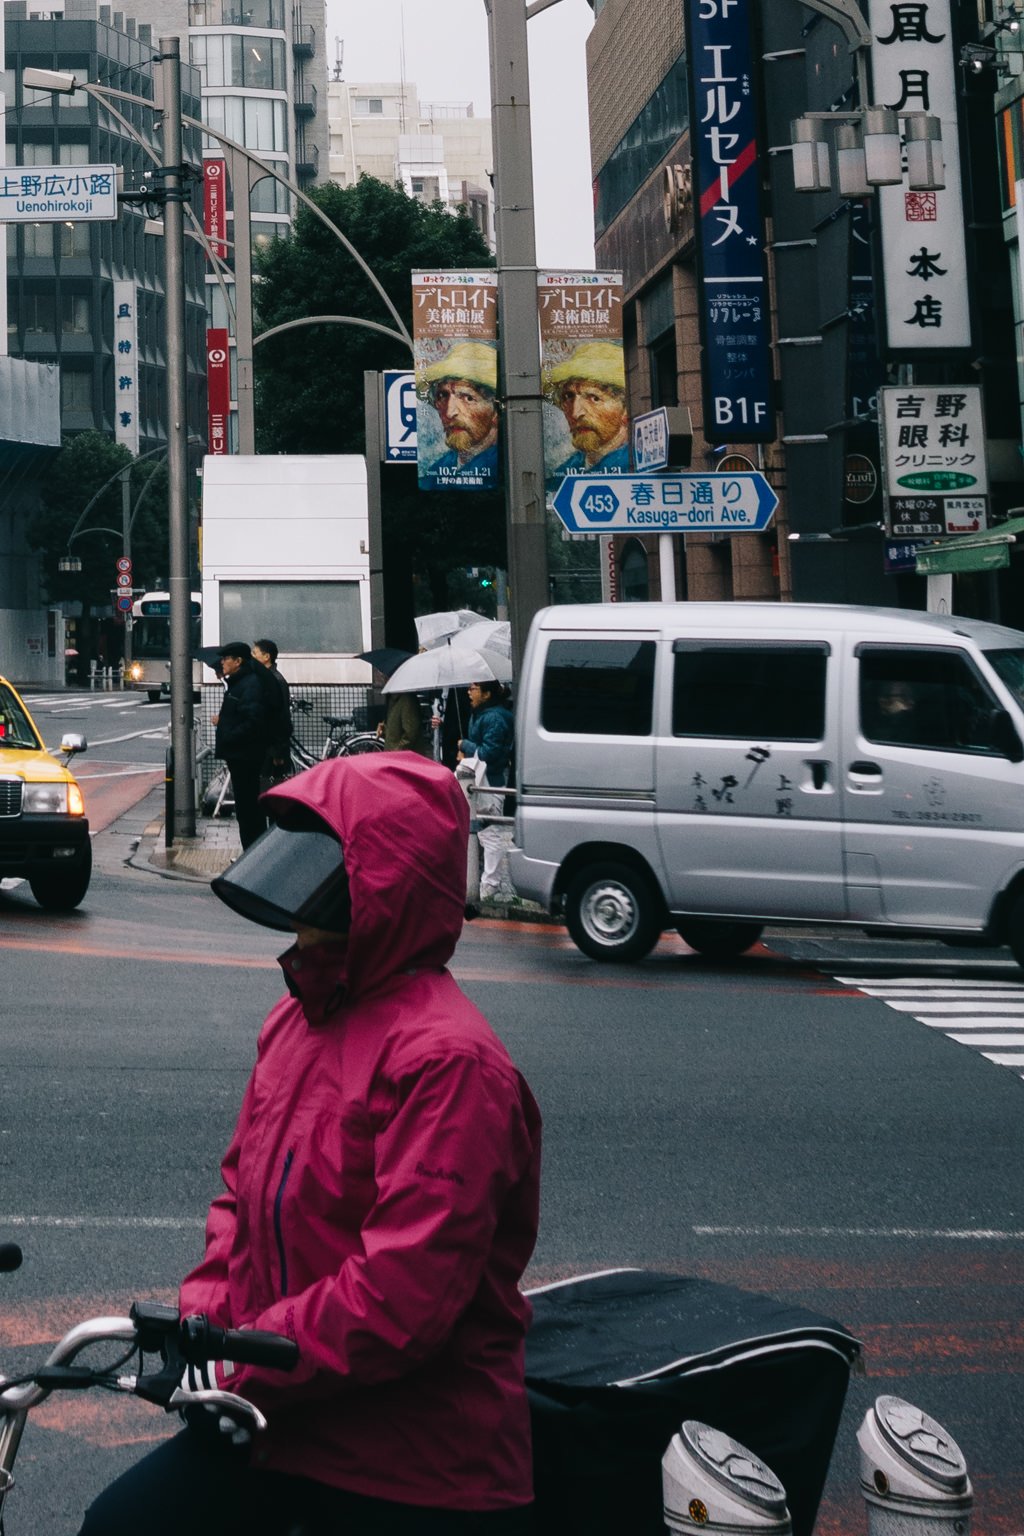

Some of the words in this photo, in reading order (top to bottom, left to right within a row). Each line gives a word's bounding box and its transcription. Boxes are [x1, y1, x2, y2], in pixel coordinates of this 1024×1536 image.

[700, 44, 744, 247] エルセーヌ
[16, 199, 93, 213] Uenohirokoji
[423, 275, 475, 283] ほっとタウンうえの
[547, 276, 598, 284] ほっとタウンうえの
[904, 246, 948, 328] 本店
[414, 287, 496, 309] デトロイト
[539, 288, 621, 309] デトロイト
[426, 308, 485, 324] 美術館展
[550, 309, 610, 325] 美術館展
[715, 335, 759, 346] 骨盤調整
[727, 352, 748, 363] 整体
[724, 367, 755, 380] リンパ
[714, 396, 767, 424] B1F
[896, 393, 967, 419] 吉野
[898, 423, 969, 449] 眼科
[895, 453, 976, 467] クリニック
[436, 477, 483, 485] 上野の森美術館
[630, 481, 742, 505] 春日通り
[585, 494, 614, 513] 453
[895, 499, 936, 510] 水曜のみ
[627, 507, 714, 526] Kasuga-dori
[720, 508, 751, 523] Ave.
